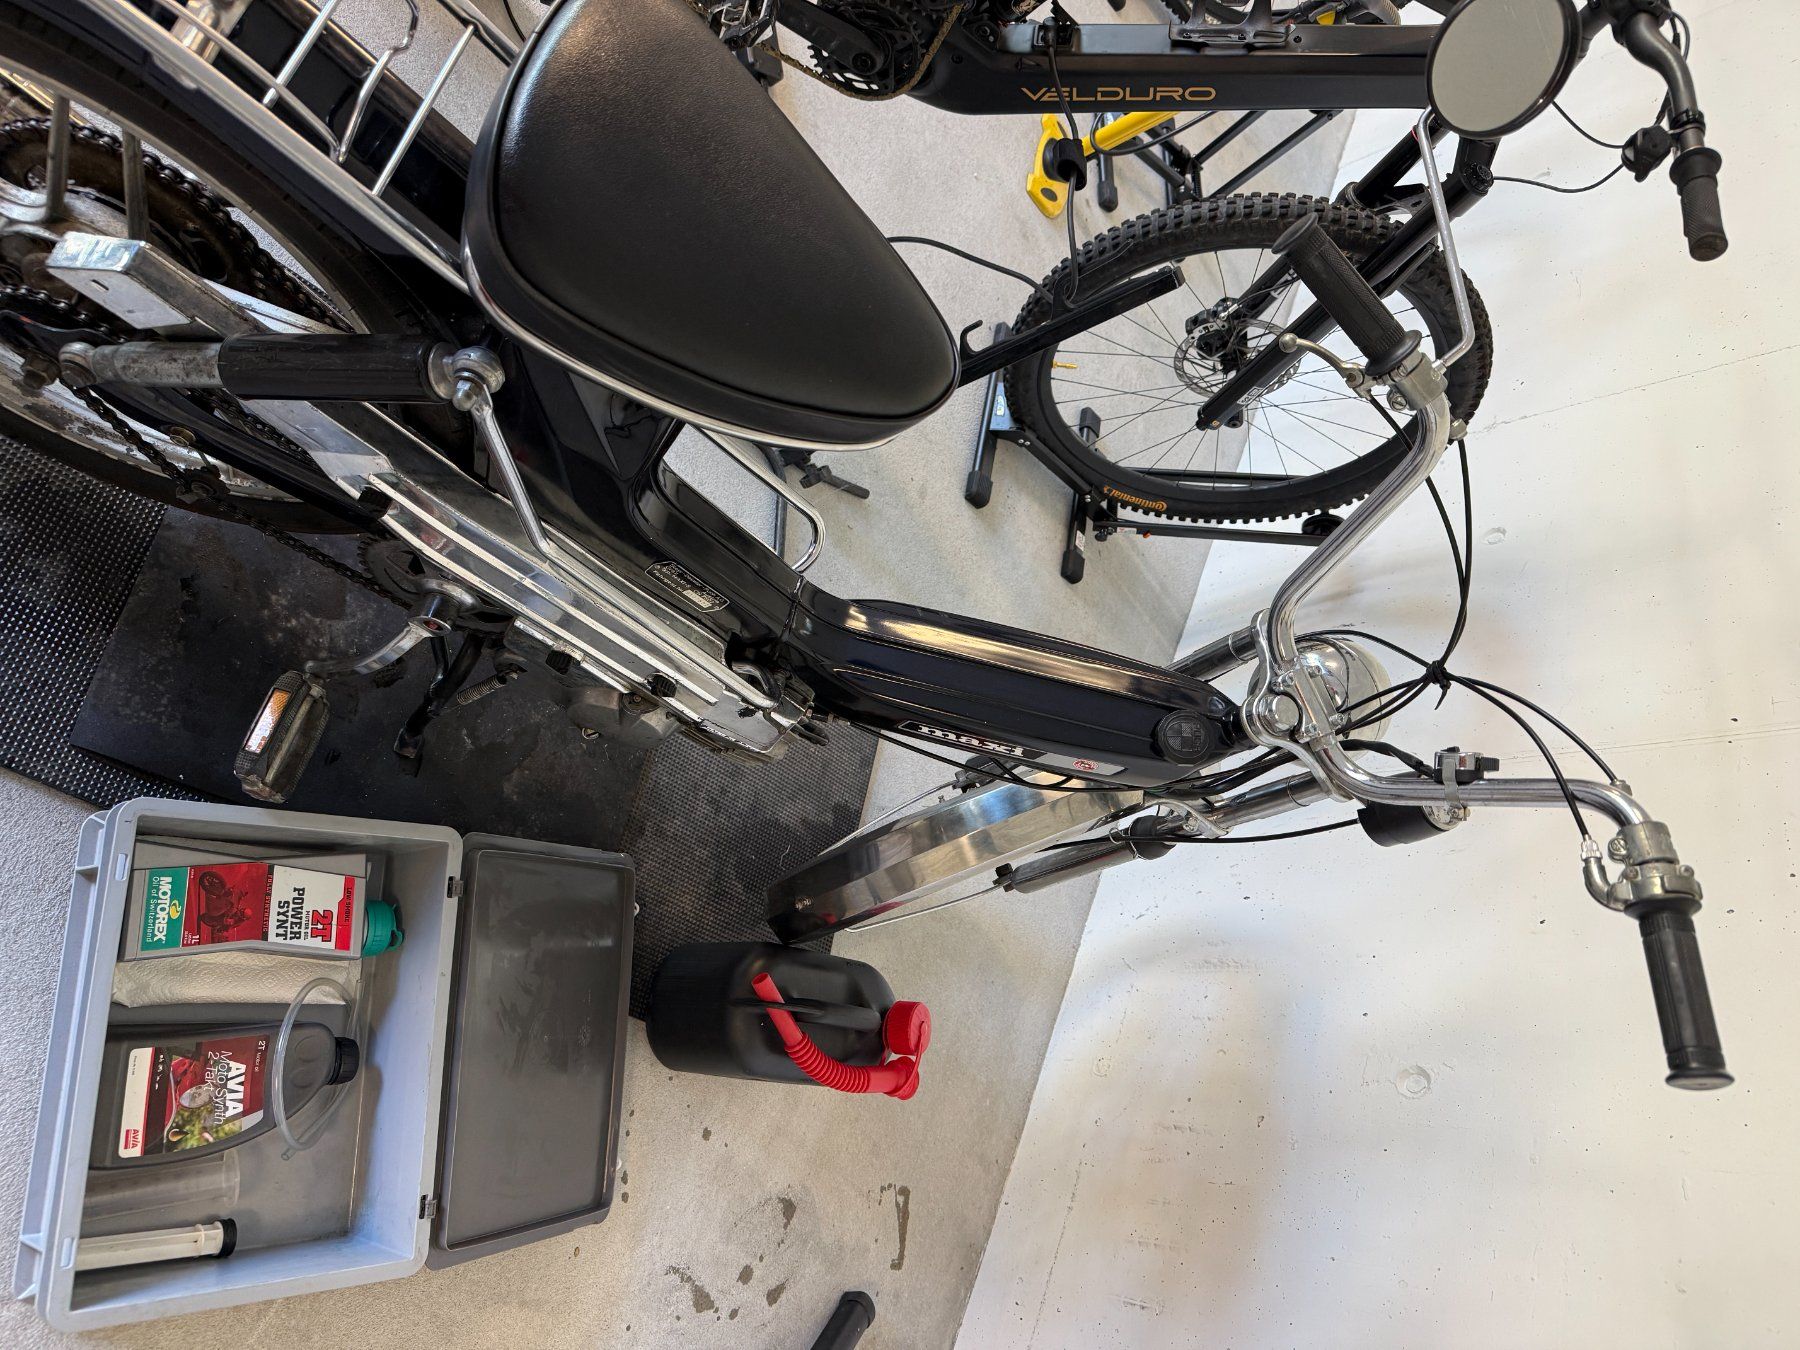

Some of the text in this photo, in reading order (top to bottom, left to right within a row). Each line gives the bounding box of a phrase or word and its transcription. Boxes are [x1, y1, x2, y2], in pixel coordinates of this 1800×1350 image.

[1020, 87, 1217, 101] VELDURO
[1109, 489, 1168, 512] Continental
[918, 725, 1023, 756] maxi
[146, 876, 160, 943] Oil of Switzerland
[153, 876, 173, 942] MOTOREX
[262, 874, 273, 932] FULLY SYNTHETIC
[275, 900, 291, 940] SYNT
[289, 887, 305, 940] POWER
[192, 934, 199, 944] 1L
[310, 910, 333, 942] 2T
[258, 1040, 266, 1051] 2T
[203, 1051, 220, 1092] 2-Takt
[212, 1050, 233, 1125] Moto Synth
[225, 1060, 247, 1118] AVIA
[131, 1128, 140, 1149] AVIA
